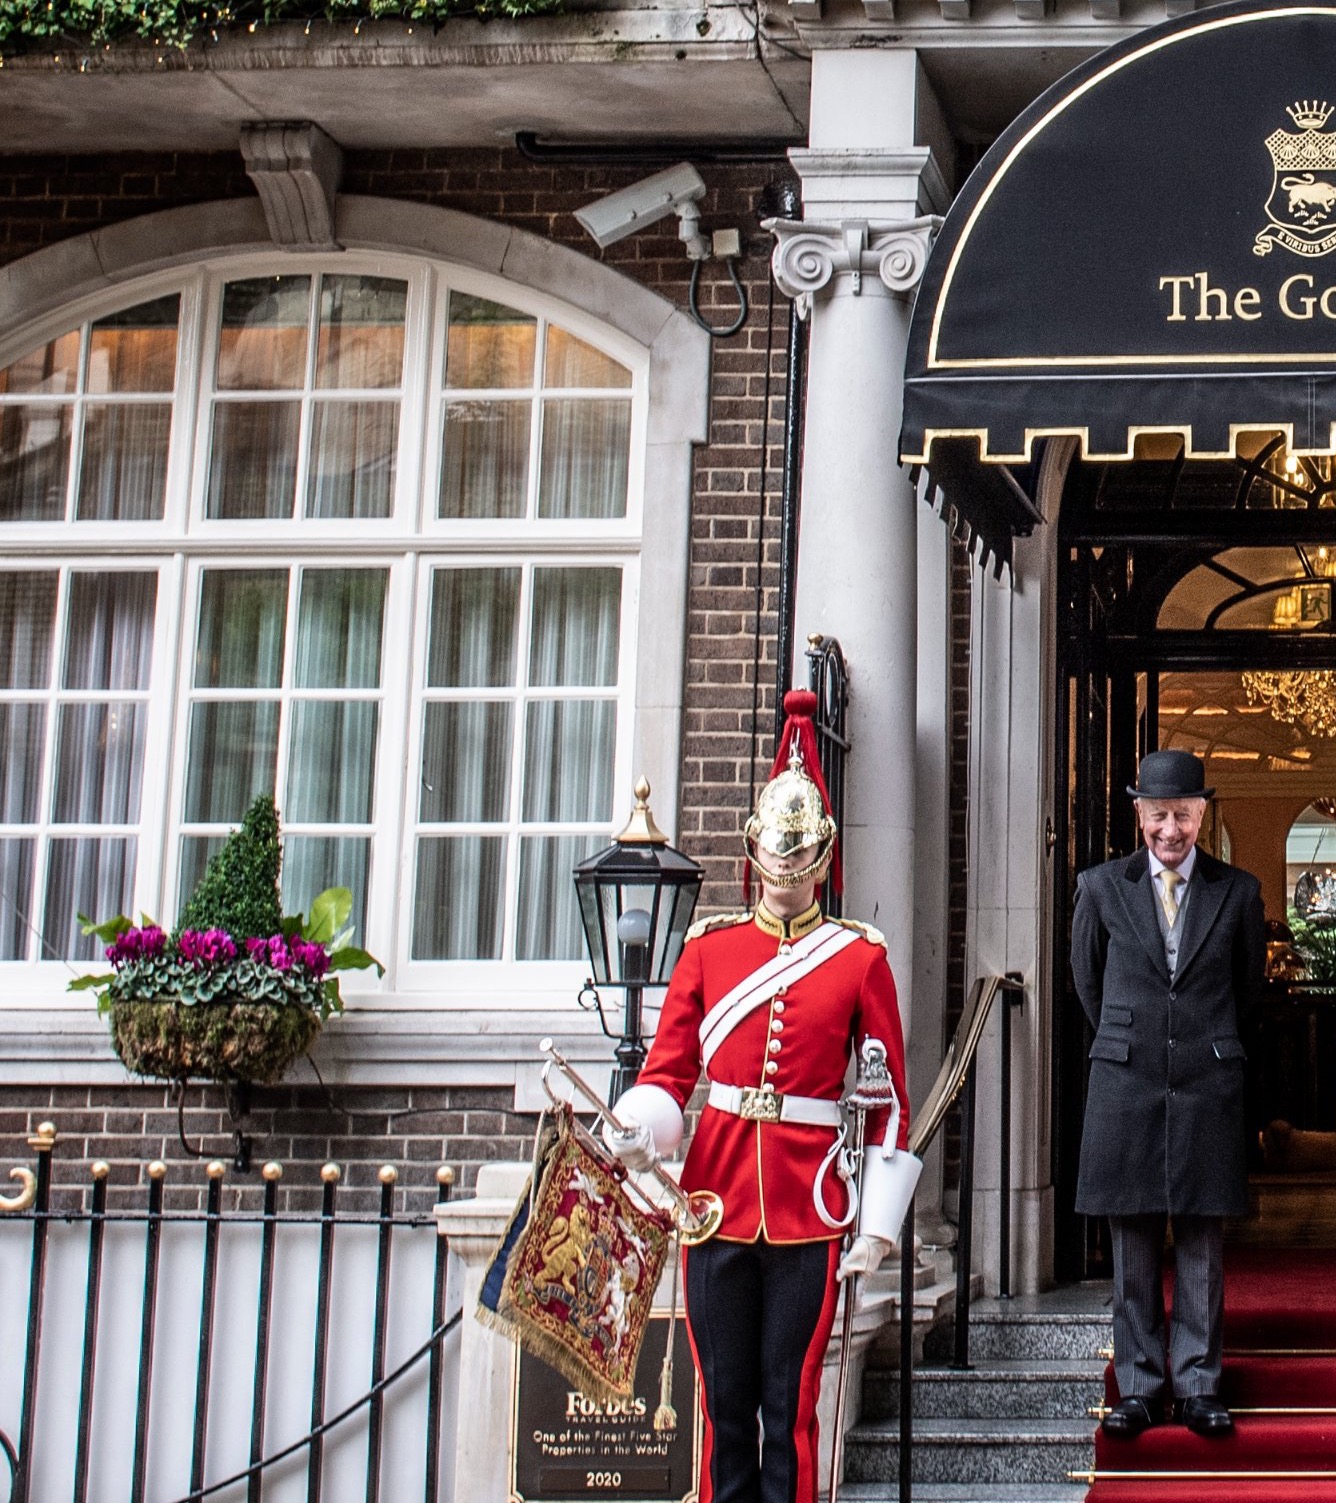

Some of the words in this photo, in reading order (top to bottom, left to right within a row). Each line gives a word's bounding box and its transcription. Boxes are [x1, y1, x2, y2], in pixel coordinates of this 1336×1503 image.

[1285, 234, 1320, 253] VIRIBUS
[1159, 272, 1262, 321] The
[533, 1430, 556, 1443] One
[559, 1429, 571, 1443] of
[574, 1429, 591, 1442] the
[595, 1430, 626, 1443] Finest
[630, 1430, 652, 1442] Five
[656, 1431, 678, 1442] Star
[542, 1443, 596, 1456] Properties
[600, 1443, 611, 1455] in
[614, 1443, 631, 1455] the
[635, 1443, 668, 1455] World
[586, 1471, 622, 1487] 2020
